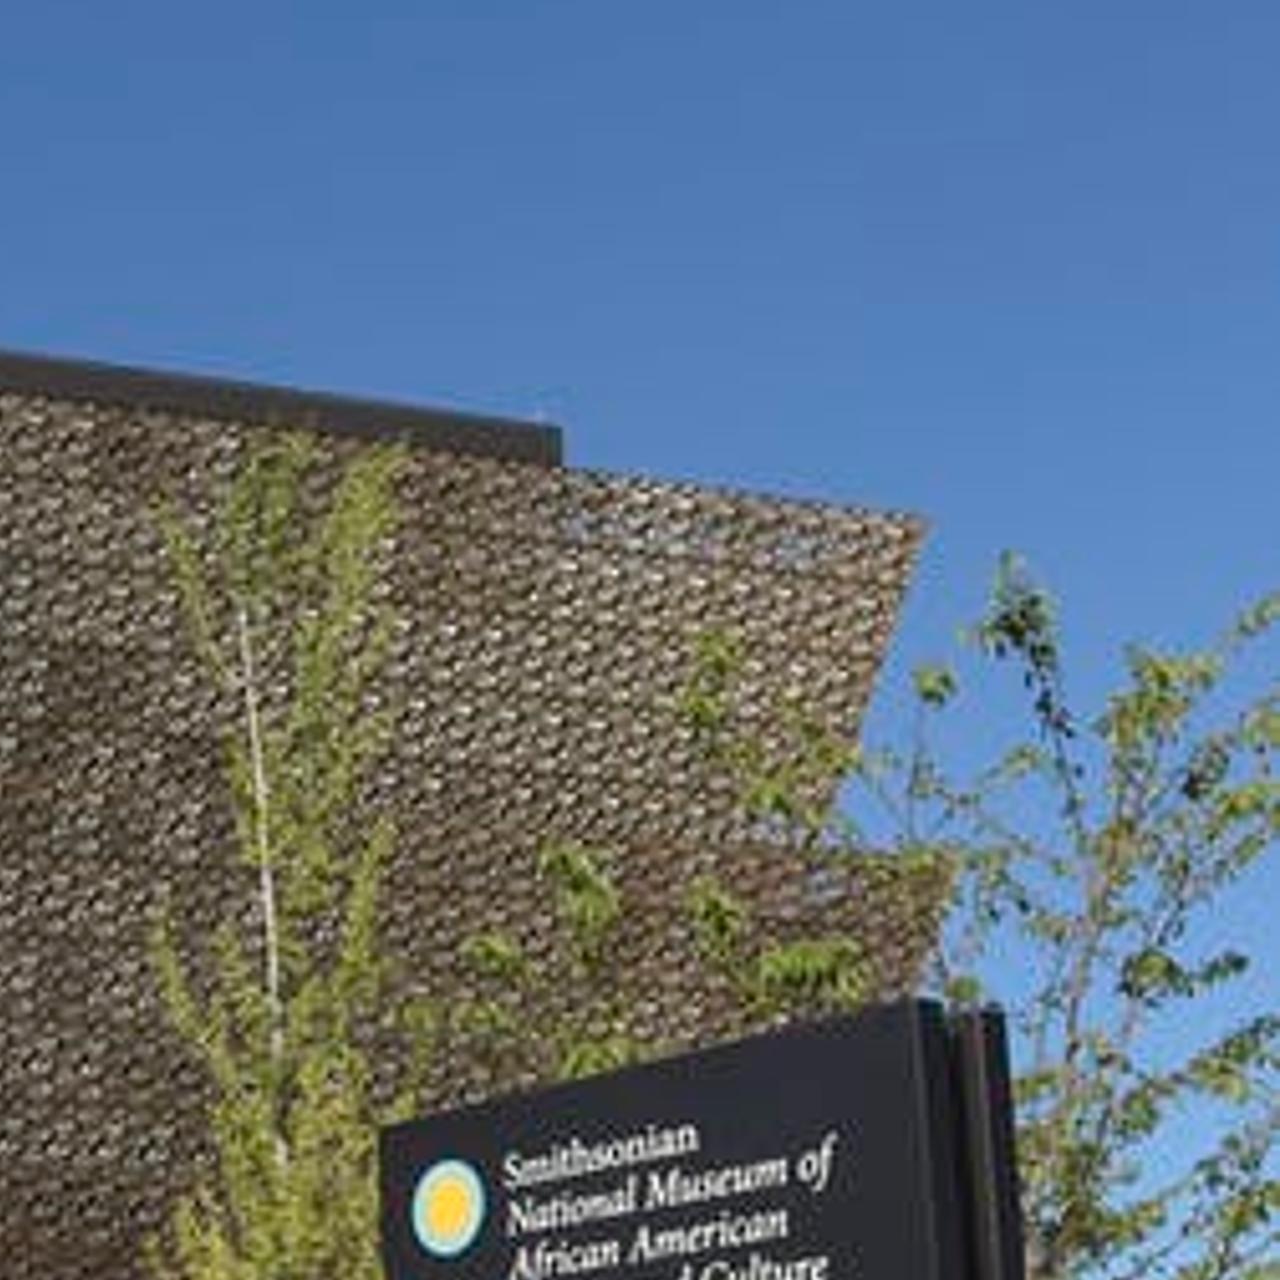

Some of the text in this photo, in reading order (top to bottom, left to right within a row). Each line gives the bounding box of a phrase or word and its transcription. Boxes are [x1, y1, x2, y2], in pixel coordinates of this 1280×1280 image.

[504, 1124, 700, 1192] Smithsonian
[508, 1131, 838, 1238] National Museum of
[626, 1209, 787, 1264] American
